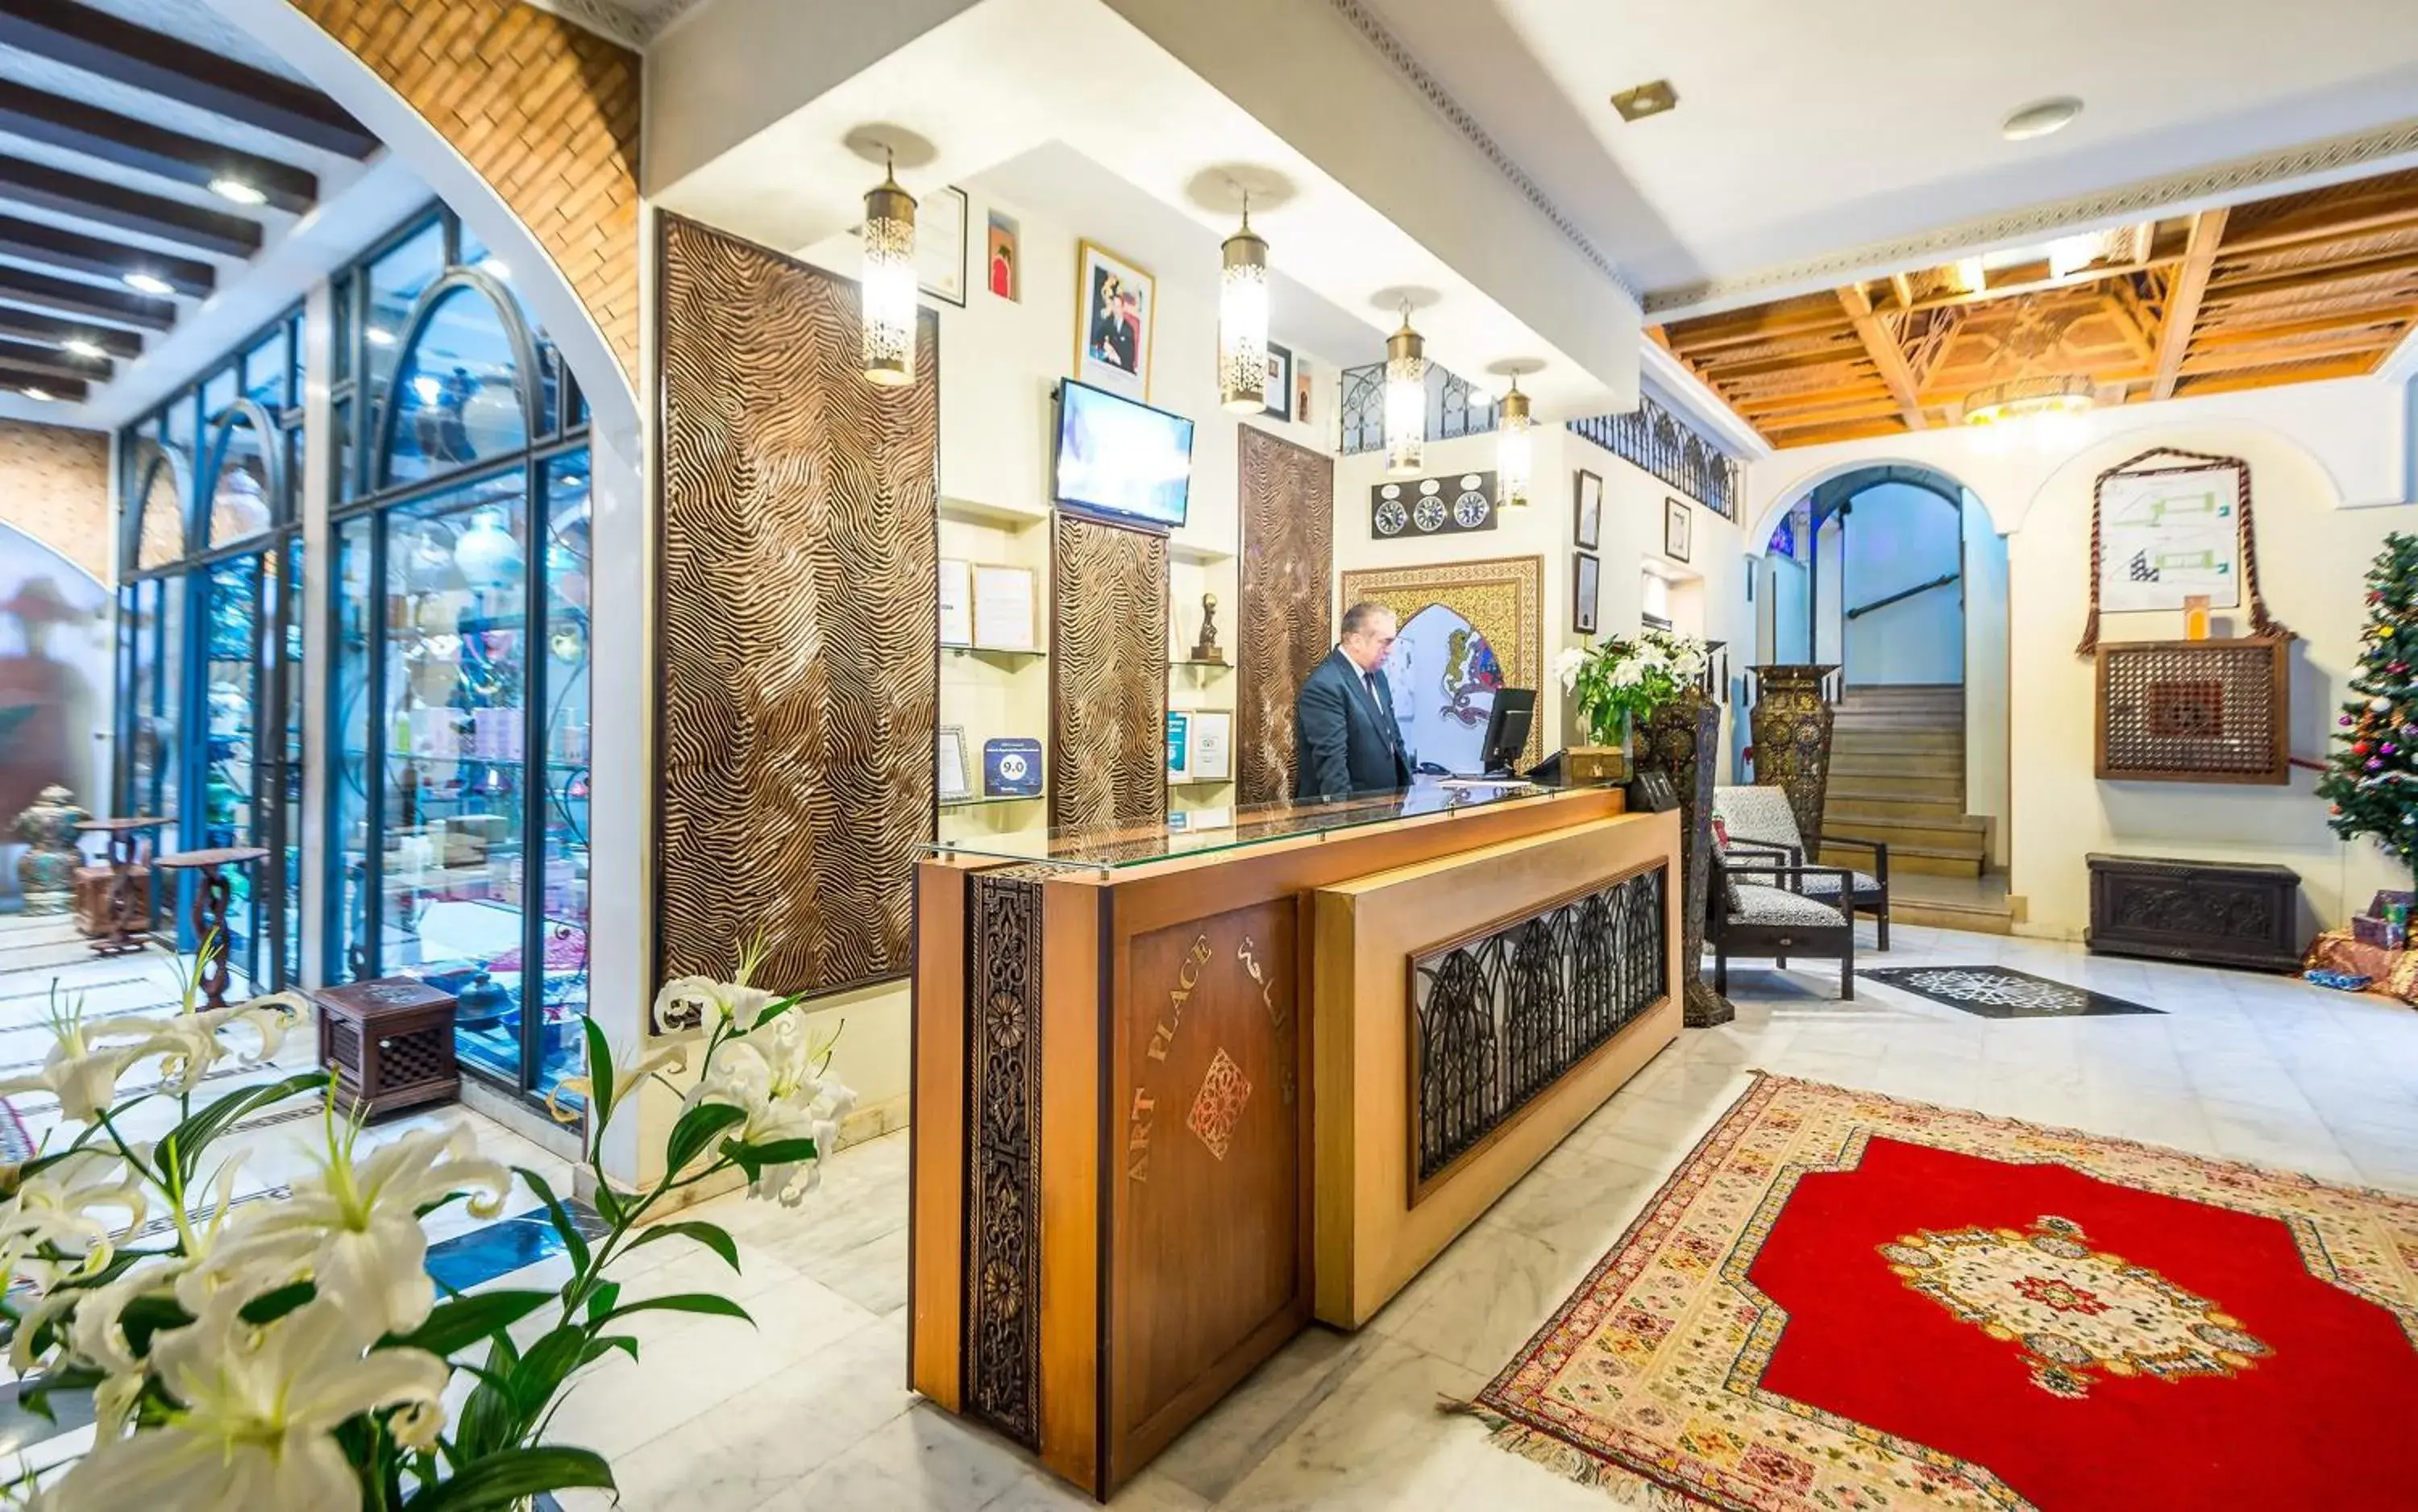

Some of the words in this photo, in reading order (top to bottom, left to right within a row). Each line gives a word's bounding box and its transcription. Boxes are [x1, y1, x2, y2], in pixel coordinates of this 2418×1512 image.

[1003, 761, 1024, 773] 9.0
[1128, 1087, 1156, 1182] ART
[1147, 934, 1212, 1062] PLACE
